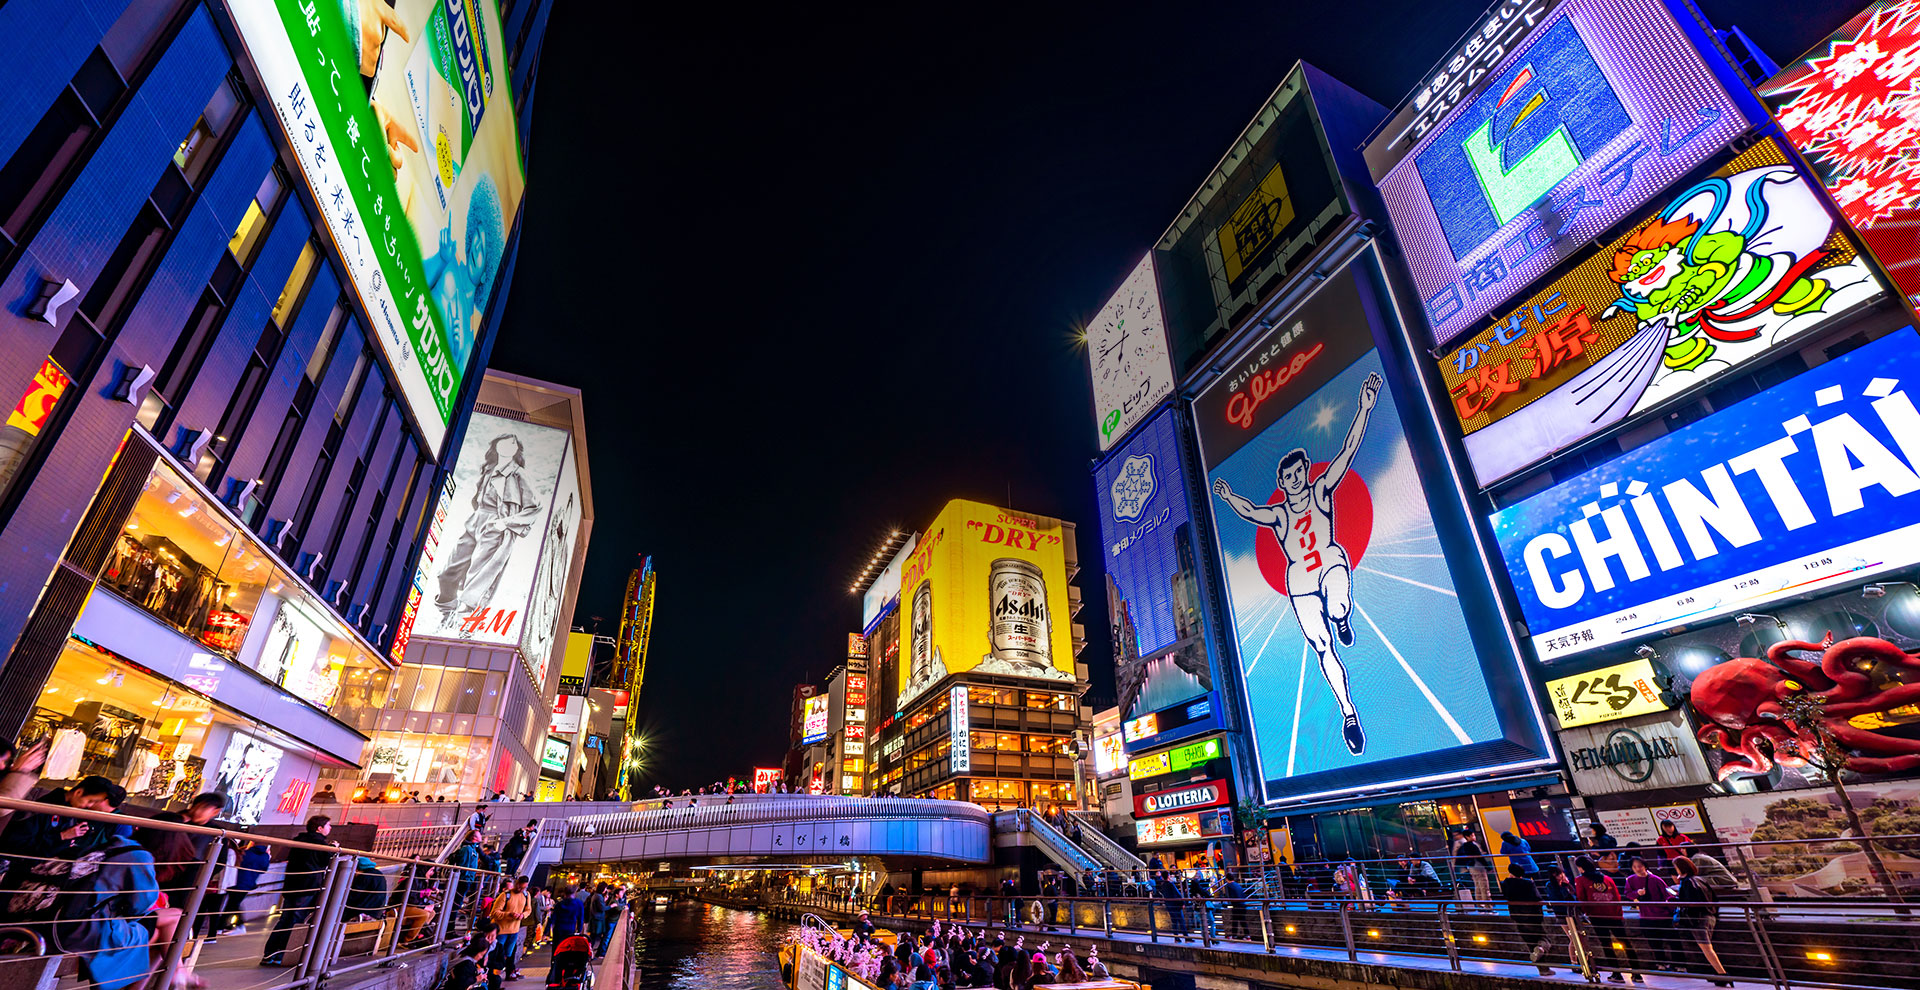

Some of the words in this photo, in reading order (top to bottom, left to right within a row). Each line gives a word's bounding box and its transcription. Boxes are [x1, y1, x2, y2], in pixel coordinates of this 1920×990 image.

[1415, 6, 1545, 138] エステムコート
[1452, 291, 1567, 374] かぜに
[412, 293, 454, 411] サロンパス
[1451, 304, 1600, 419] 改源
[1122, 376, 1151, 414] ピップ
[1226, 343, 1322, 428] Glico
[997, 514, 1036, 530] SUPER
[1112, 507, 1169, 557] 雪印メグミルク
[1294, 510, 1322, 572] グリコ
[1803, 556, 1834, 571] 18時
[1733, 577, 1760, 590] 12時
[460, 606, 518, 637] H&M
[995, 594, 1044, 622] Asahi
[1014, 624, 1028, 635] 生
[1545, 629, 1594, 652] 天気予報
[1571, 673, 1637, 711] くくる
[1158, 788, 1211, 808] LOTTERIA
[775, 834, 850, 847] えびす橋
